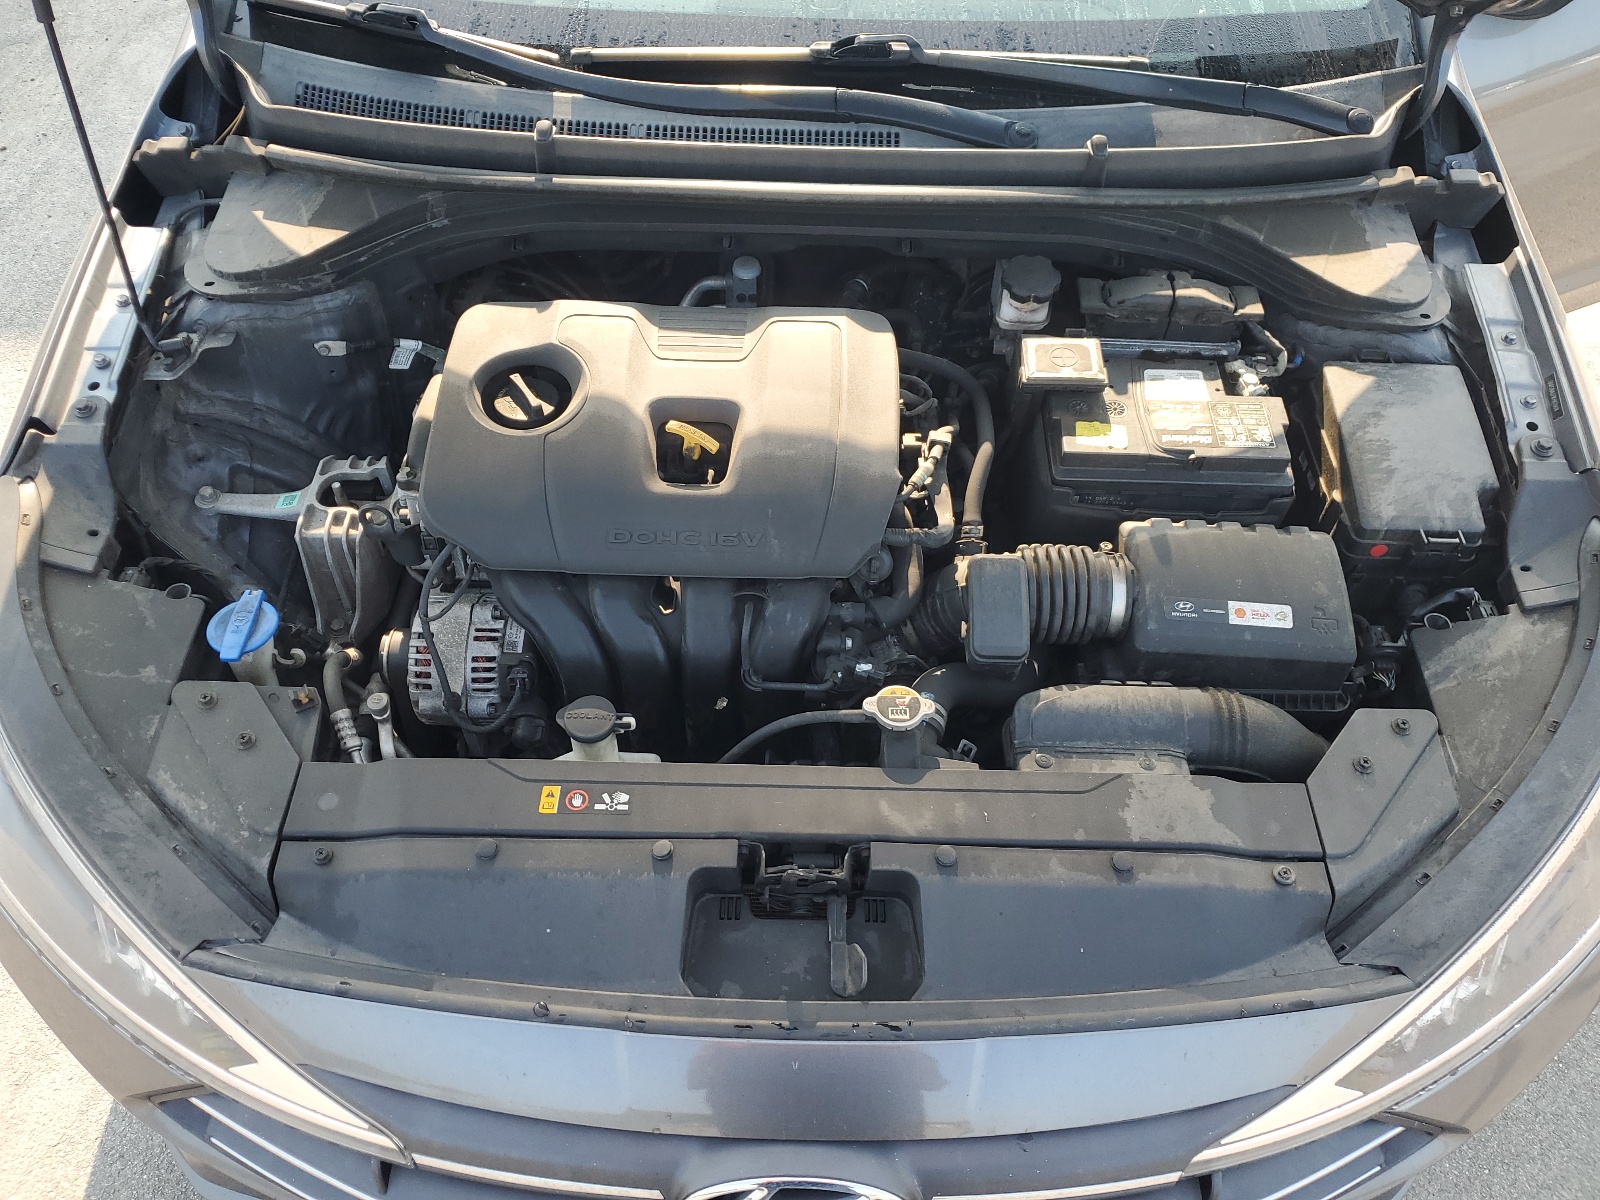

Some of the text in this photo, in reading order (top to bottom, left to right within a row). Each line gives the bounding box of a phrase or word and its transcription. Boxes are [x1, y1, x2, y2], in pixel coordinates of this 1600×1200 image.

[608, 528, 764, 548] DOHC 16V
[565, 711, 615, 722] COOLANT
